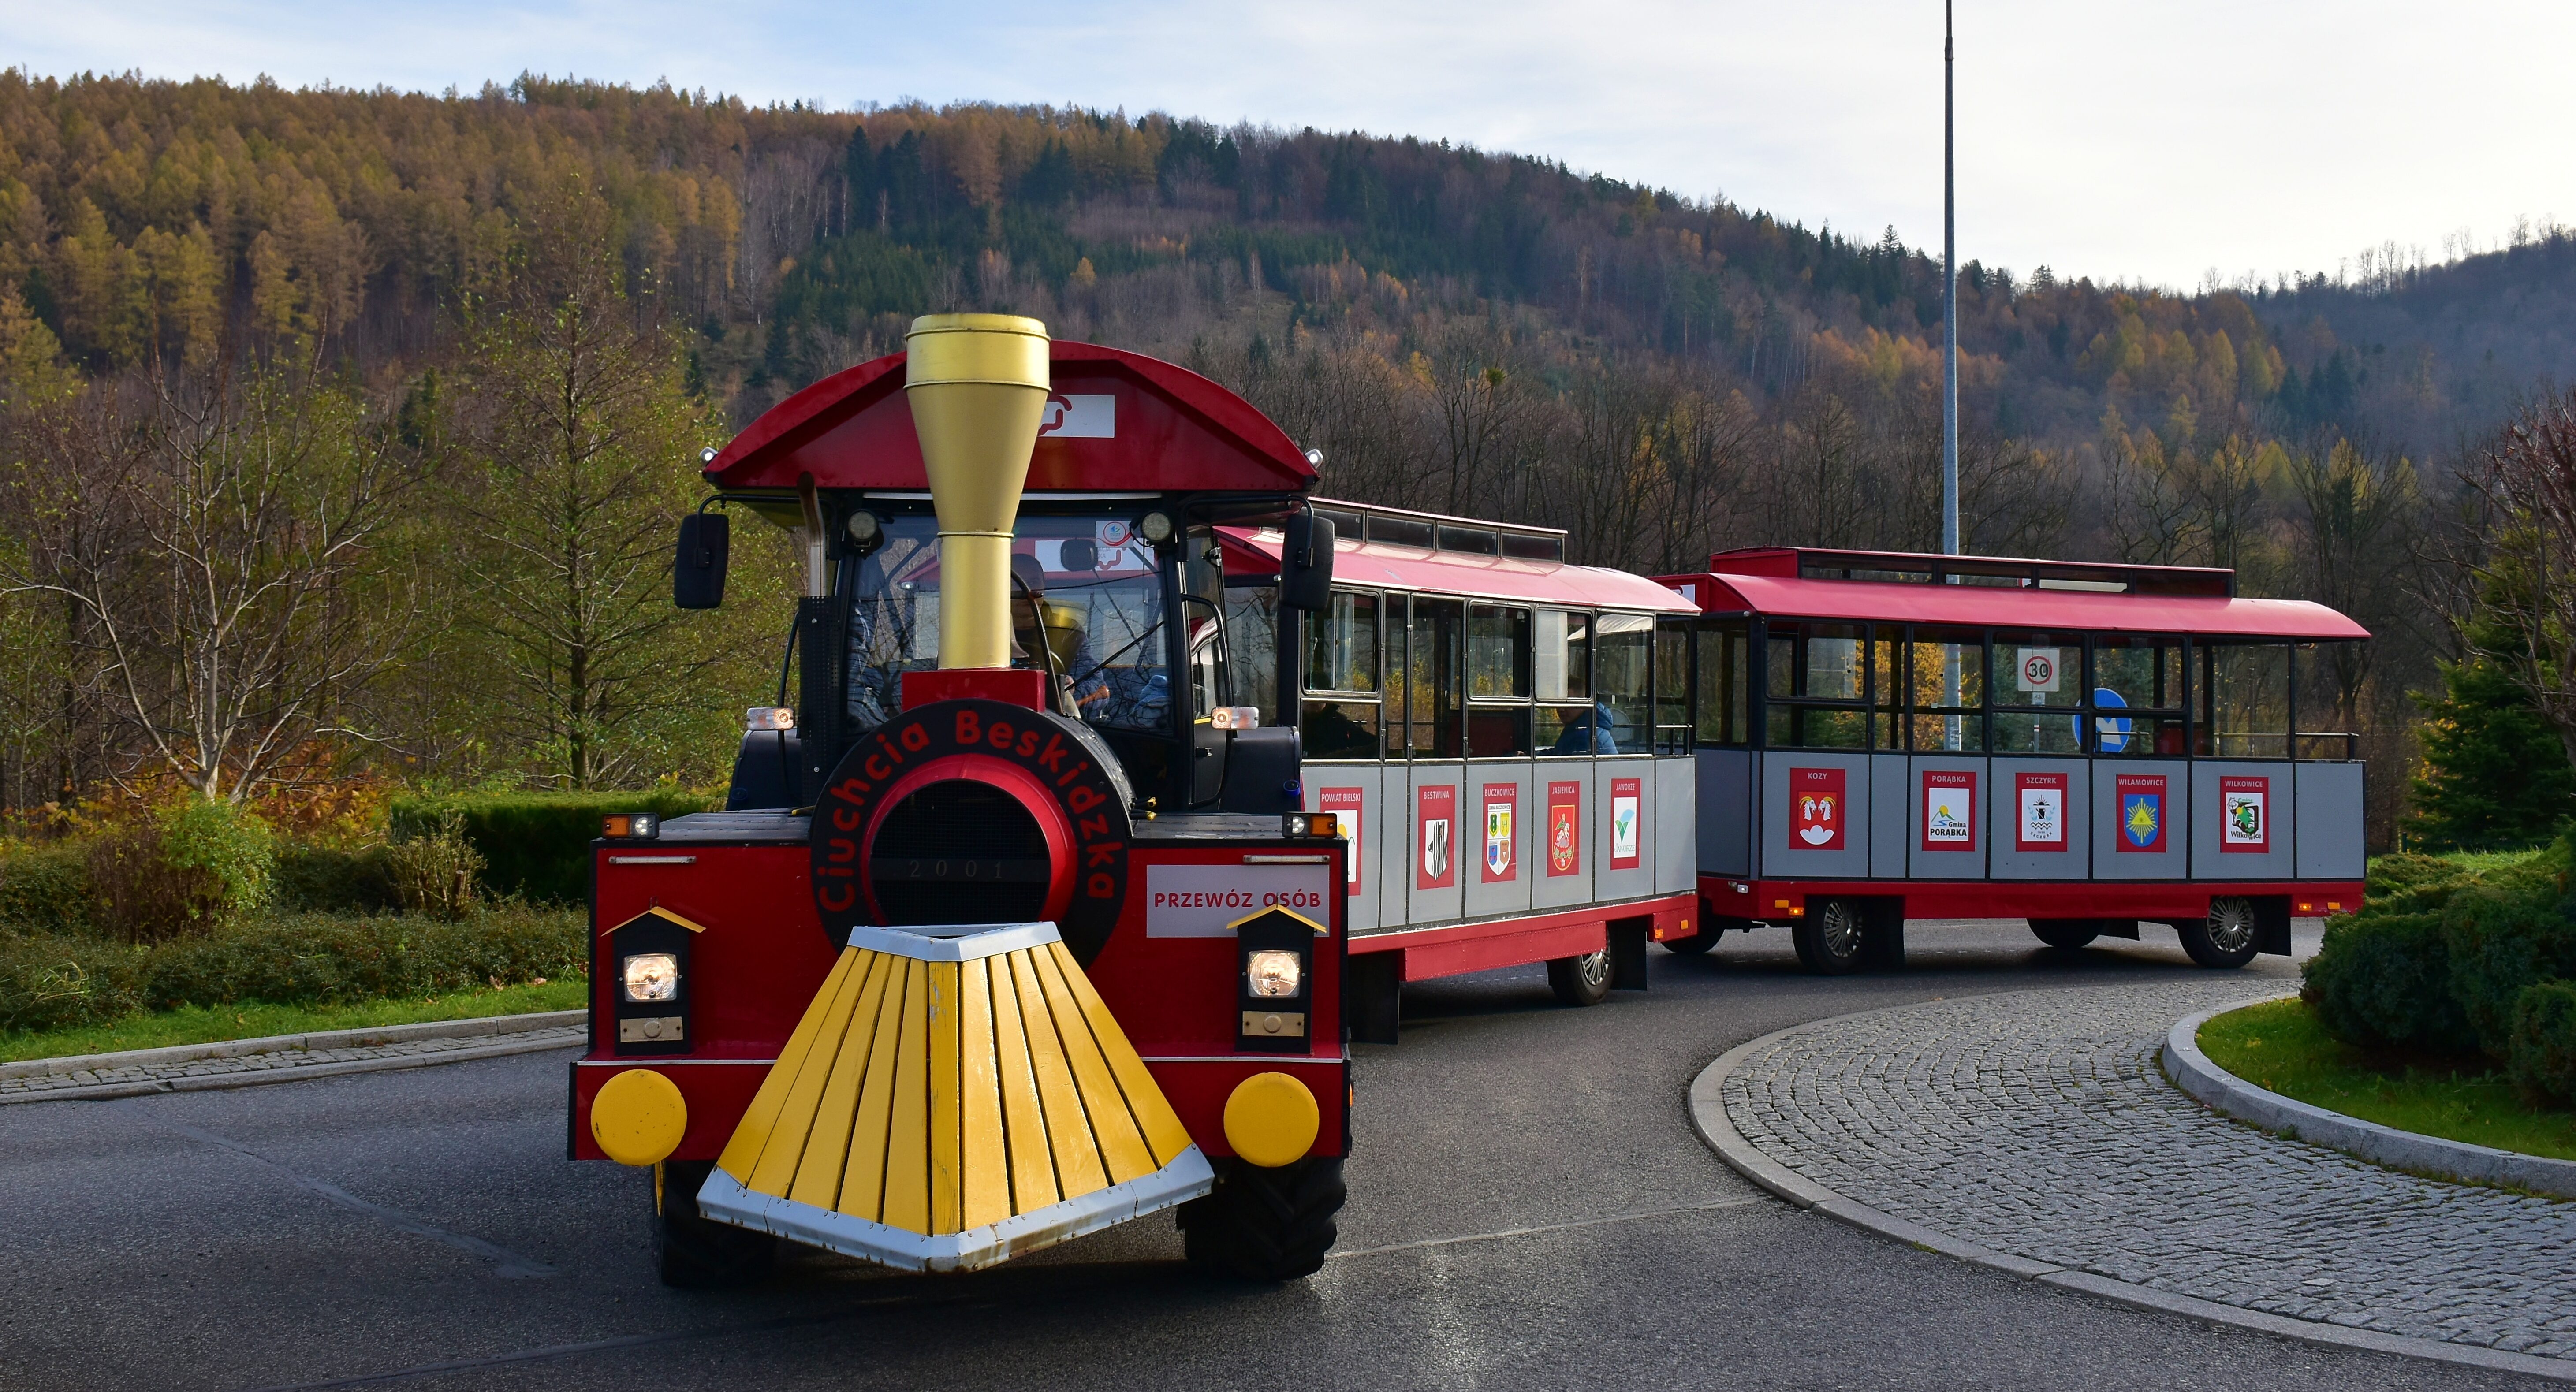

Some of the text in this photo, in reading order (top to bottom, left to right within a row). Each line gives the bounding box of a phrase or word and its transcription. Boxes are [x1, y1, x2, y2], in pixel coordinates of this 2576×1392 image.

[2028, 663, 2048, 678] 30
[1932, 775, 1966, 784] PORĄBKA
[1424, 790, 1450, 800] BESTWINA
[1484, 788, 1514, 797] BUCZKOWICE
[1552, 786, 1575, 794] JASIENICA
[1321, 793, 1361, 802] POWIAT BIELSKI
[817, 710, 1123, 912] Ciuchcia Beskidzka
[1930, 829, 1967, 838] PORĄBKA
[2231, 831, 2262, 841] Wilkowice
[909, 860, 1002, 878] 2001
[1154, 888, 1320, 908] PRZEWÓZ OSÓB
